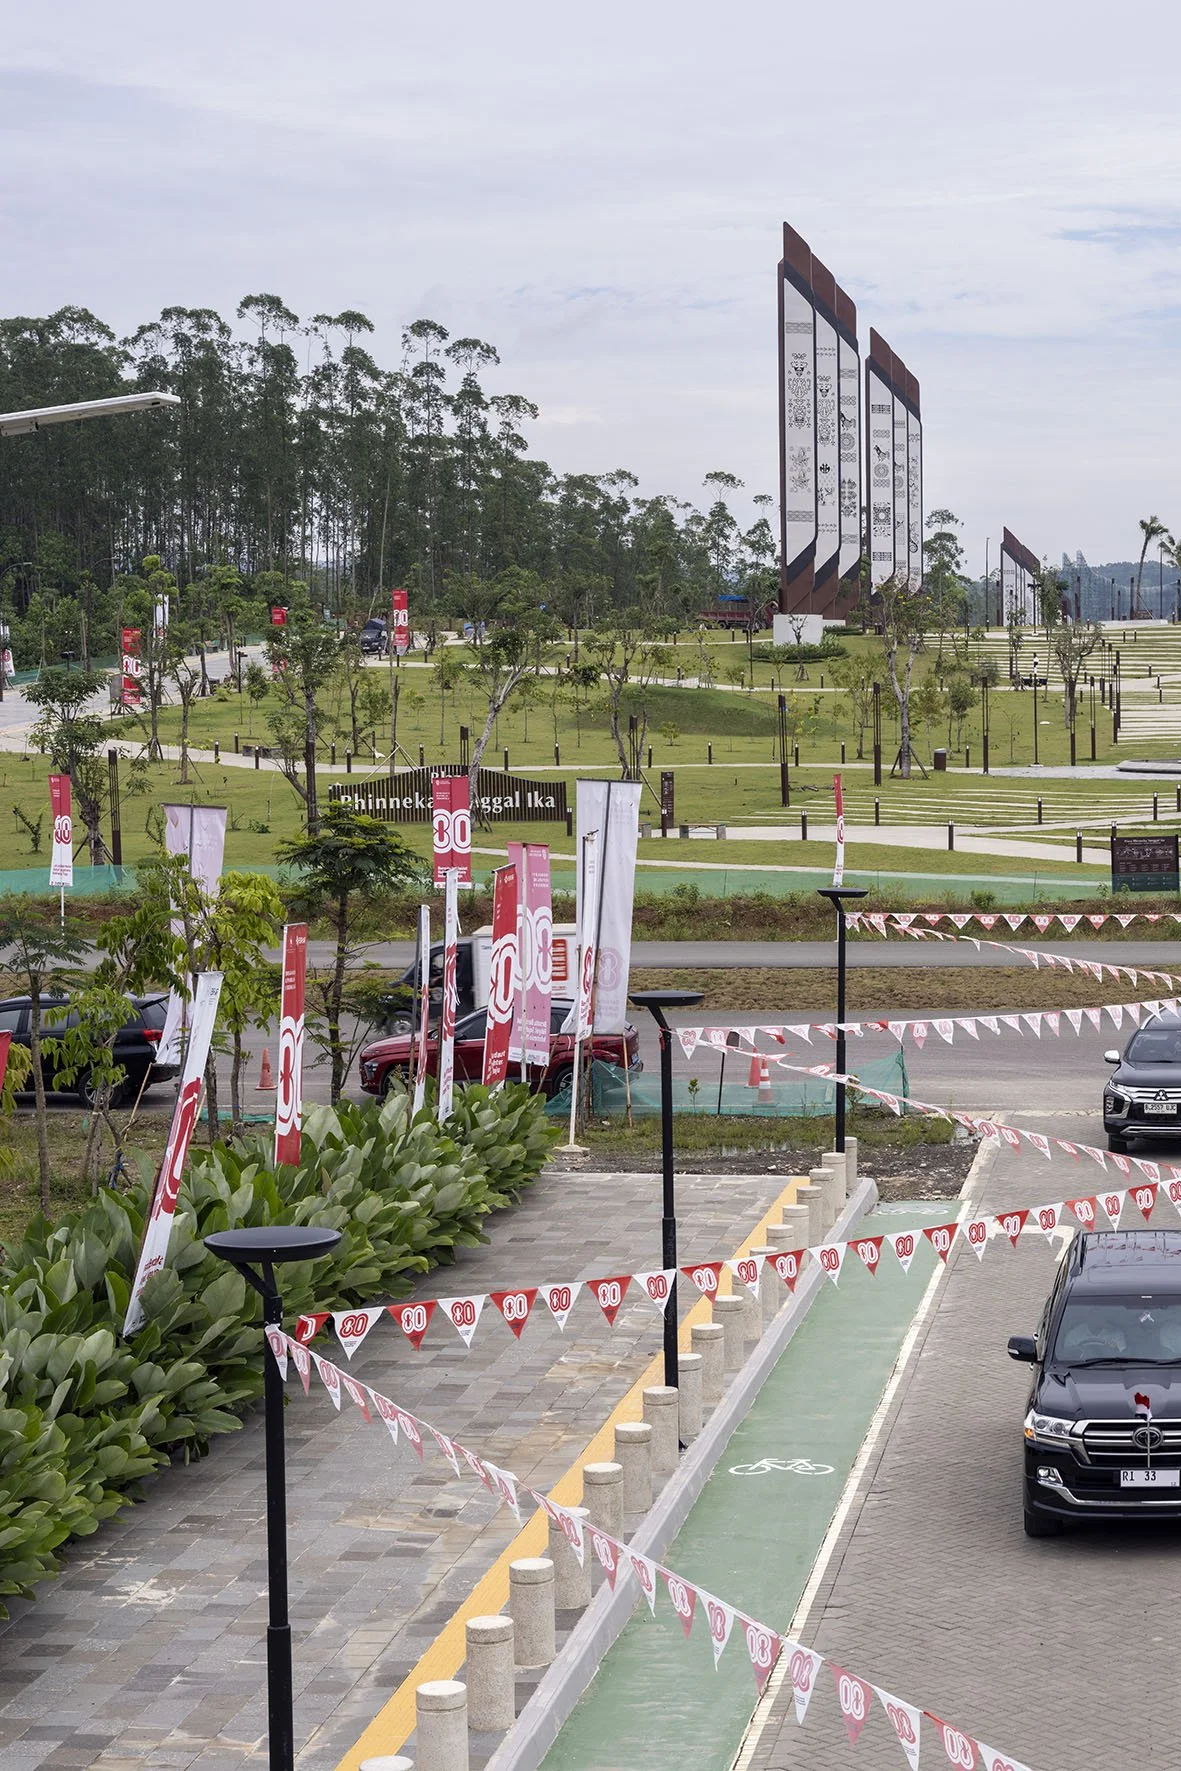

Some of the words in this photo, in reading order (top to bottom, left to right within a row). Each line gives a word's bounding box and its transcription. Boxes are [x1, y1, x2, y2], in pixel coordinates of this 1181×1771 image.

[528, 792, 555, 808] Ika
[433, 809, 471, 854] 80
[1104, 1195, 1120, 1216] 80
[1136, 1188, 1153, 1209] 80
[1039, 1208, 1056, 1229] 80
[1075, 1201, 1094, 1221] 80
[969, 1222, 986, 1242] 80
[1003, 1214, 1020, 1236] 80
[896, 1234, 914, 1257] 80
[932, 1228, 950, 1250] 80
[820, 1248, 840, 1270] 80
[858, 1240, 878, 1264] 80
[738, 1260, 758, 1283] 80
[776, 1254, 796, 1278] 80
[646, 1274, 668, 1300] 80
[692, 1268, 717, 1292] 80
[550, 1286, 571, 1311] 80
[598, 1281, 620, 1306] 80
[402, 1304, 427, 1332] 80
[451, 1300, 476, 1325] 80
[502, 1294, 528, 1320] 80
[340, 1313, 368, 1338] 80
[1122, 1471, 1135, 1481] RI
[1144, 1471, 1157, 1481] 33
